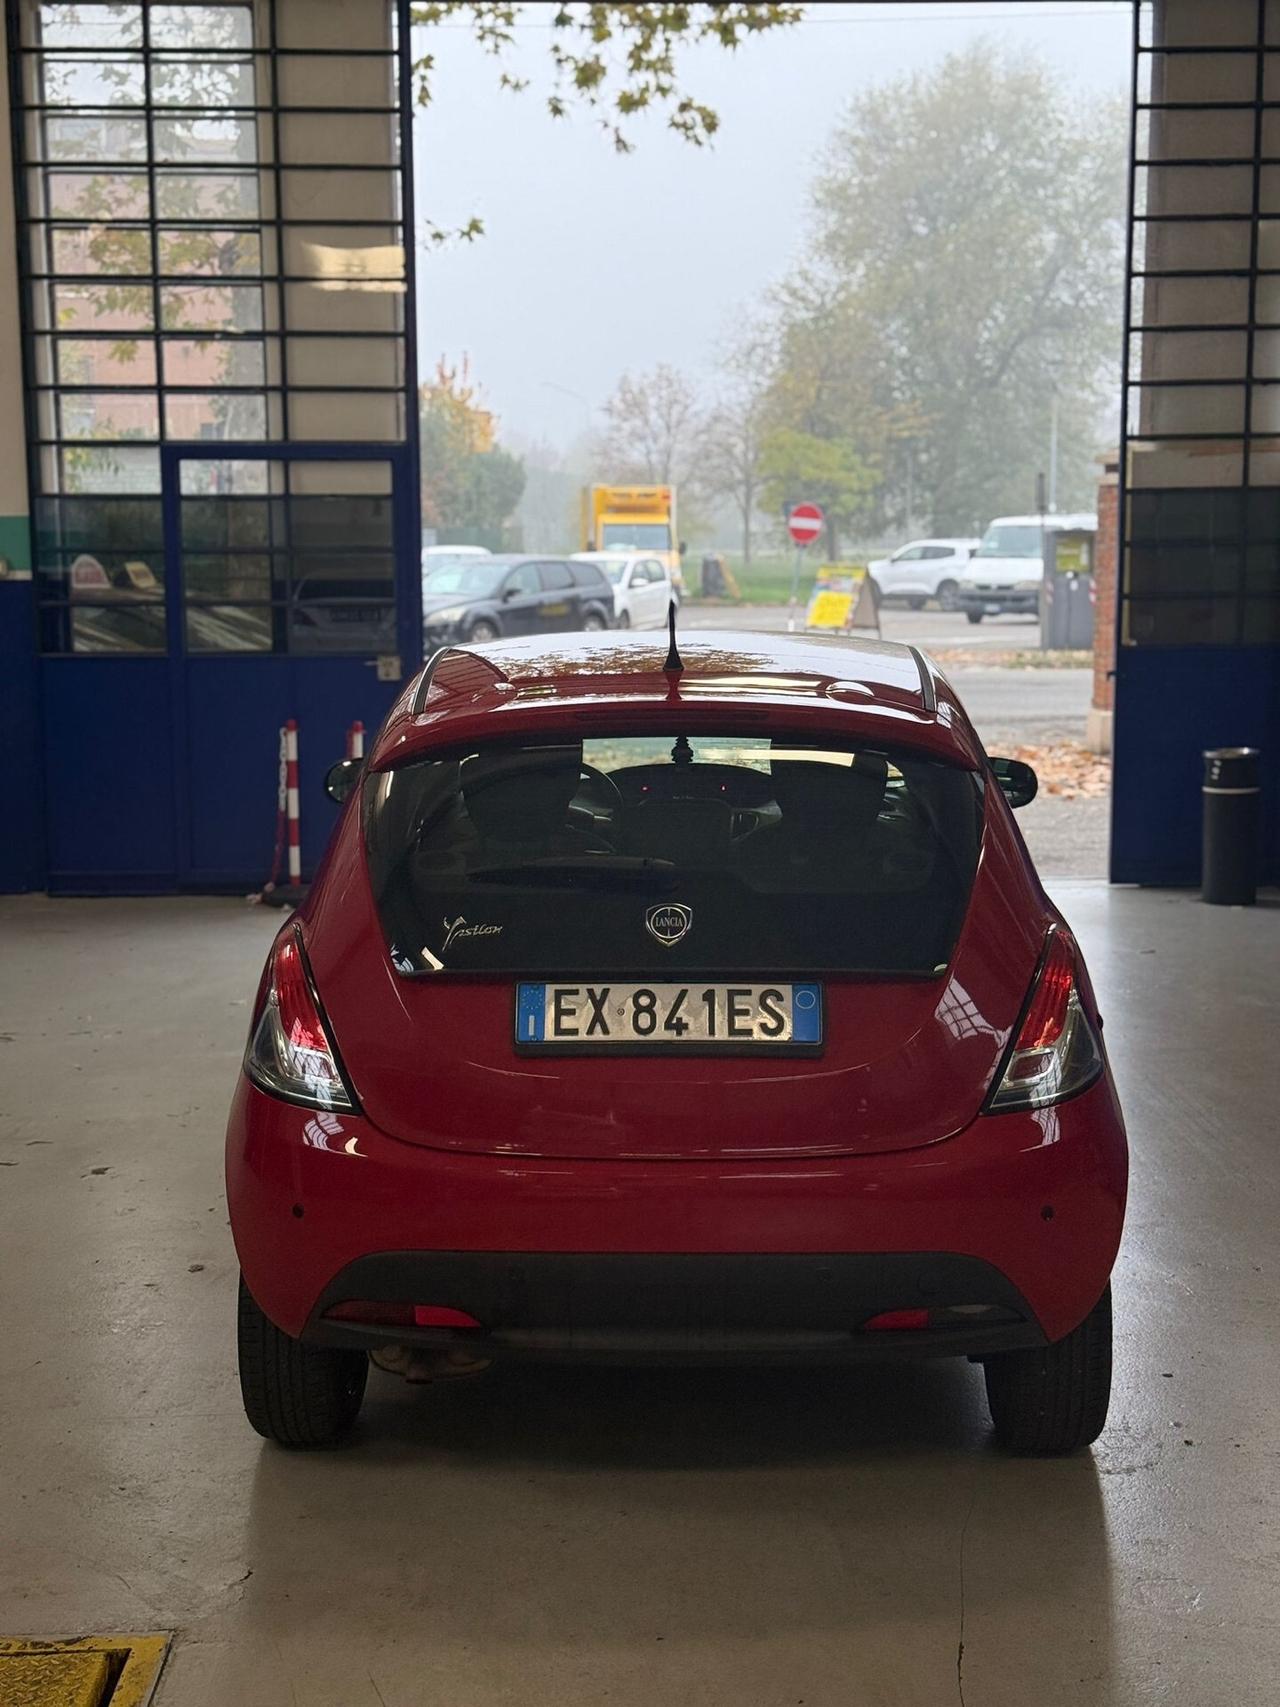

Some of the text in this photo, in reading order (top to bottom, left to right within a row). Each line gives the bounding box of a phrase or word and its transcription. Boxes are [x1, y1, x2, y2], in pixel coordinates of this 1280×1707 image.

[442, 916, 503, 952] Ypsilon
[655, 916, 683, 927] LANCIA
[553, 988, 786, 1036] EX 841ES
